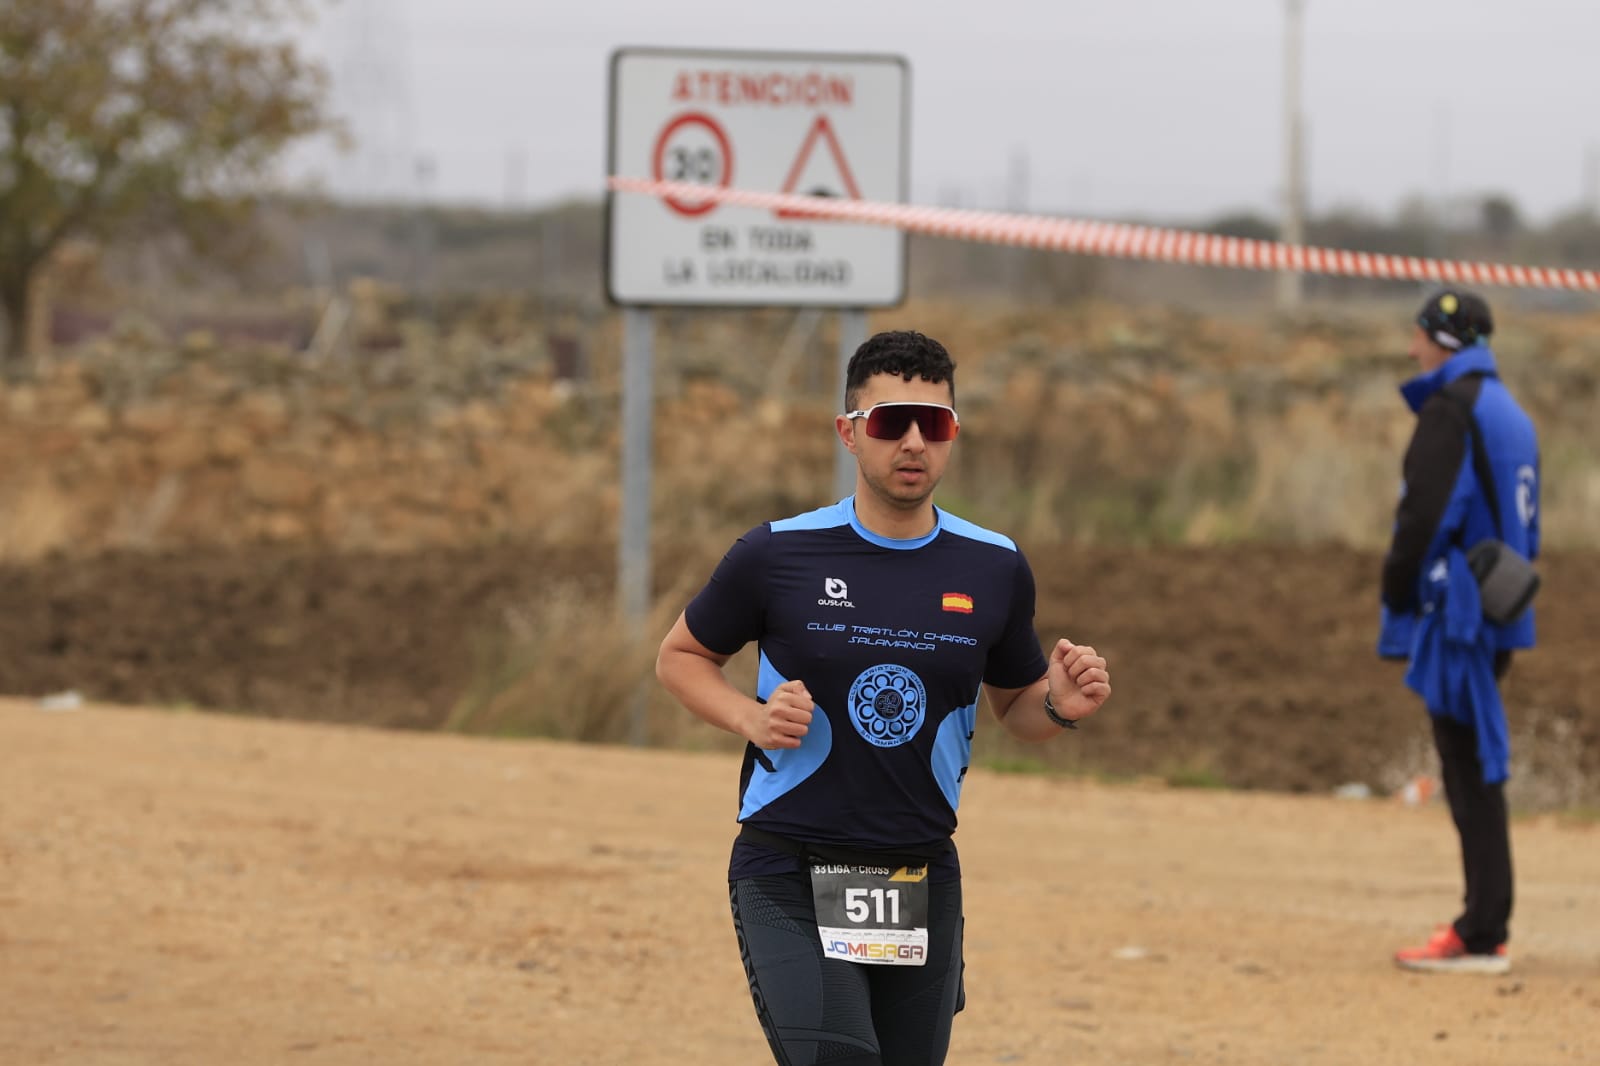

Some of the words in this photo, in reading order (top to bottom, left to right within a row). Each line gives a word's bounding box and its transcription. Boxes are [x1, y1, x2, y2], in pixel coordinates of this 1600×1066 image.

[672, 69, 852, 105] ATENCIÓN
[671, 148, 714, 181] 30
[702, 228, 734, 251] EN
[751, 229, 813, 252] TODA
[665, 260, 694, 284] LA
[709, 261, 850, 285] LOCALIDAD
[807, 622, 846, 631] CLUB
[923, 632, 978, 646] CHARRO
[847, 635, 936, 652] SALAMANCA
[849, 678, 863, 702] CLUB
[860, 729, 911, 747] SALAMANCA
[814, 865, 827, 874] 33
[828, 864, 851, 874] LIGA
[845, 888, 900, 924] 511
[826, 940, 924, 960] JOMISAGA
